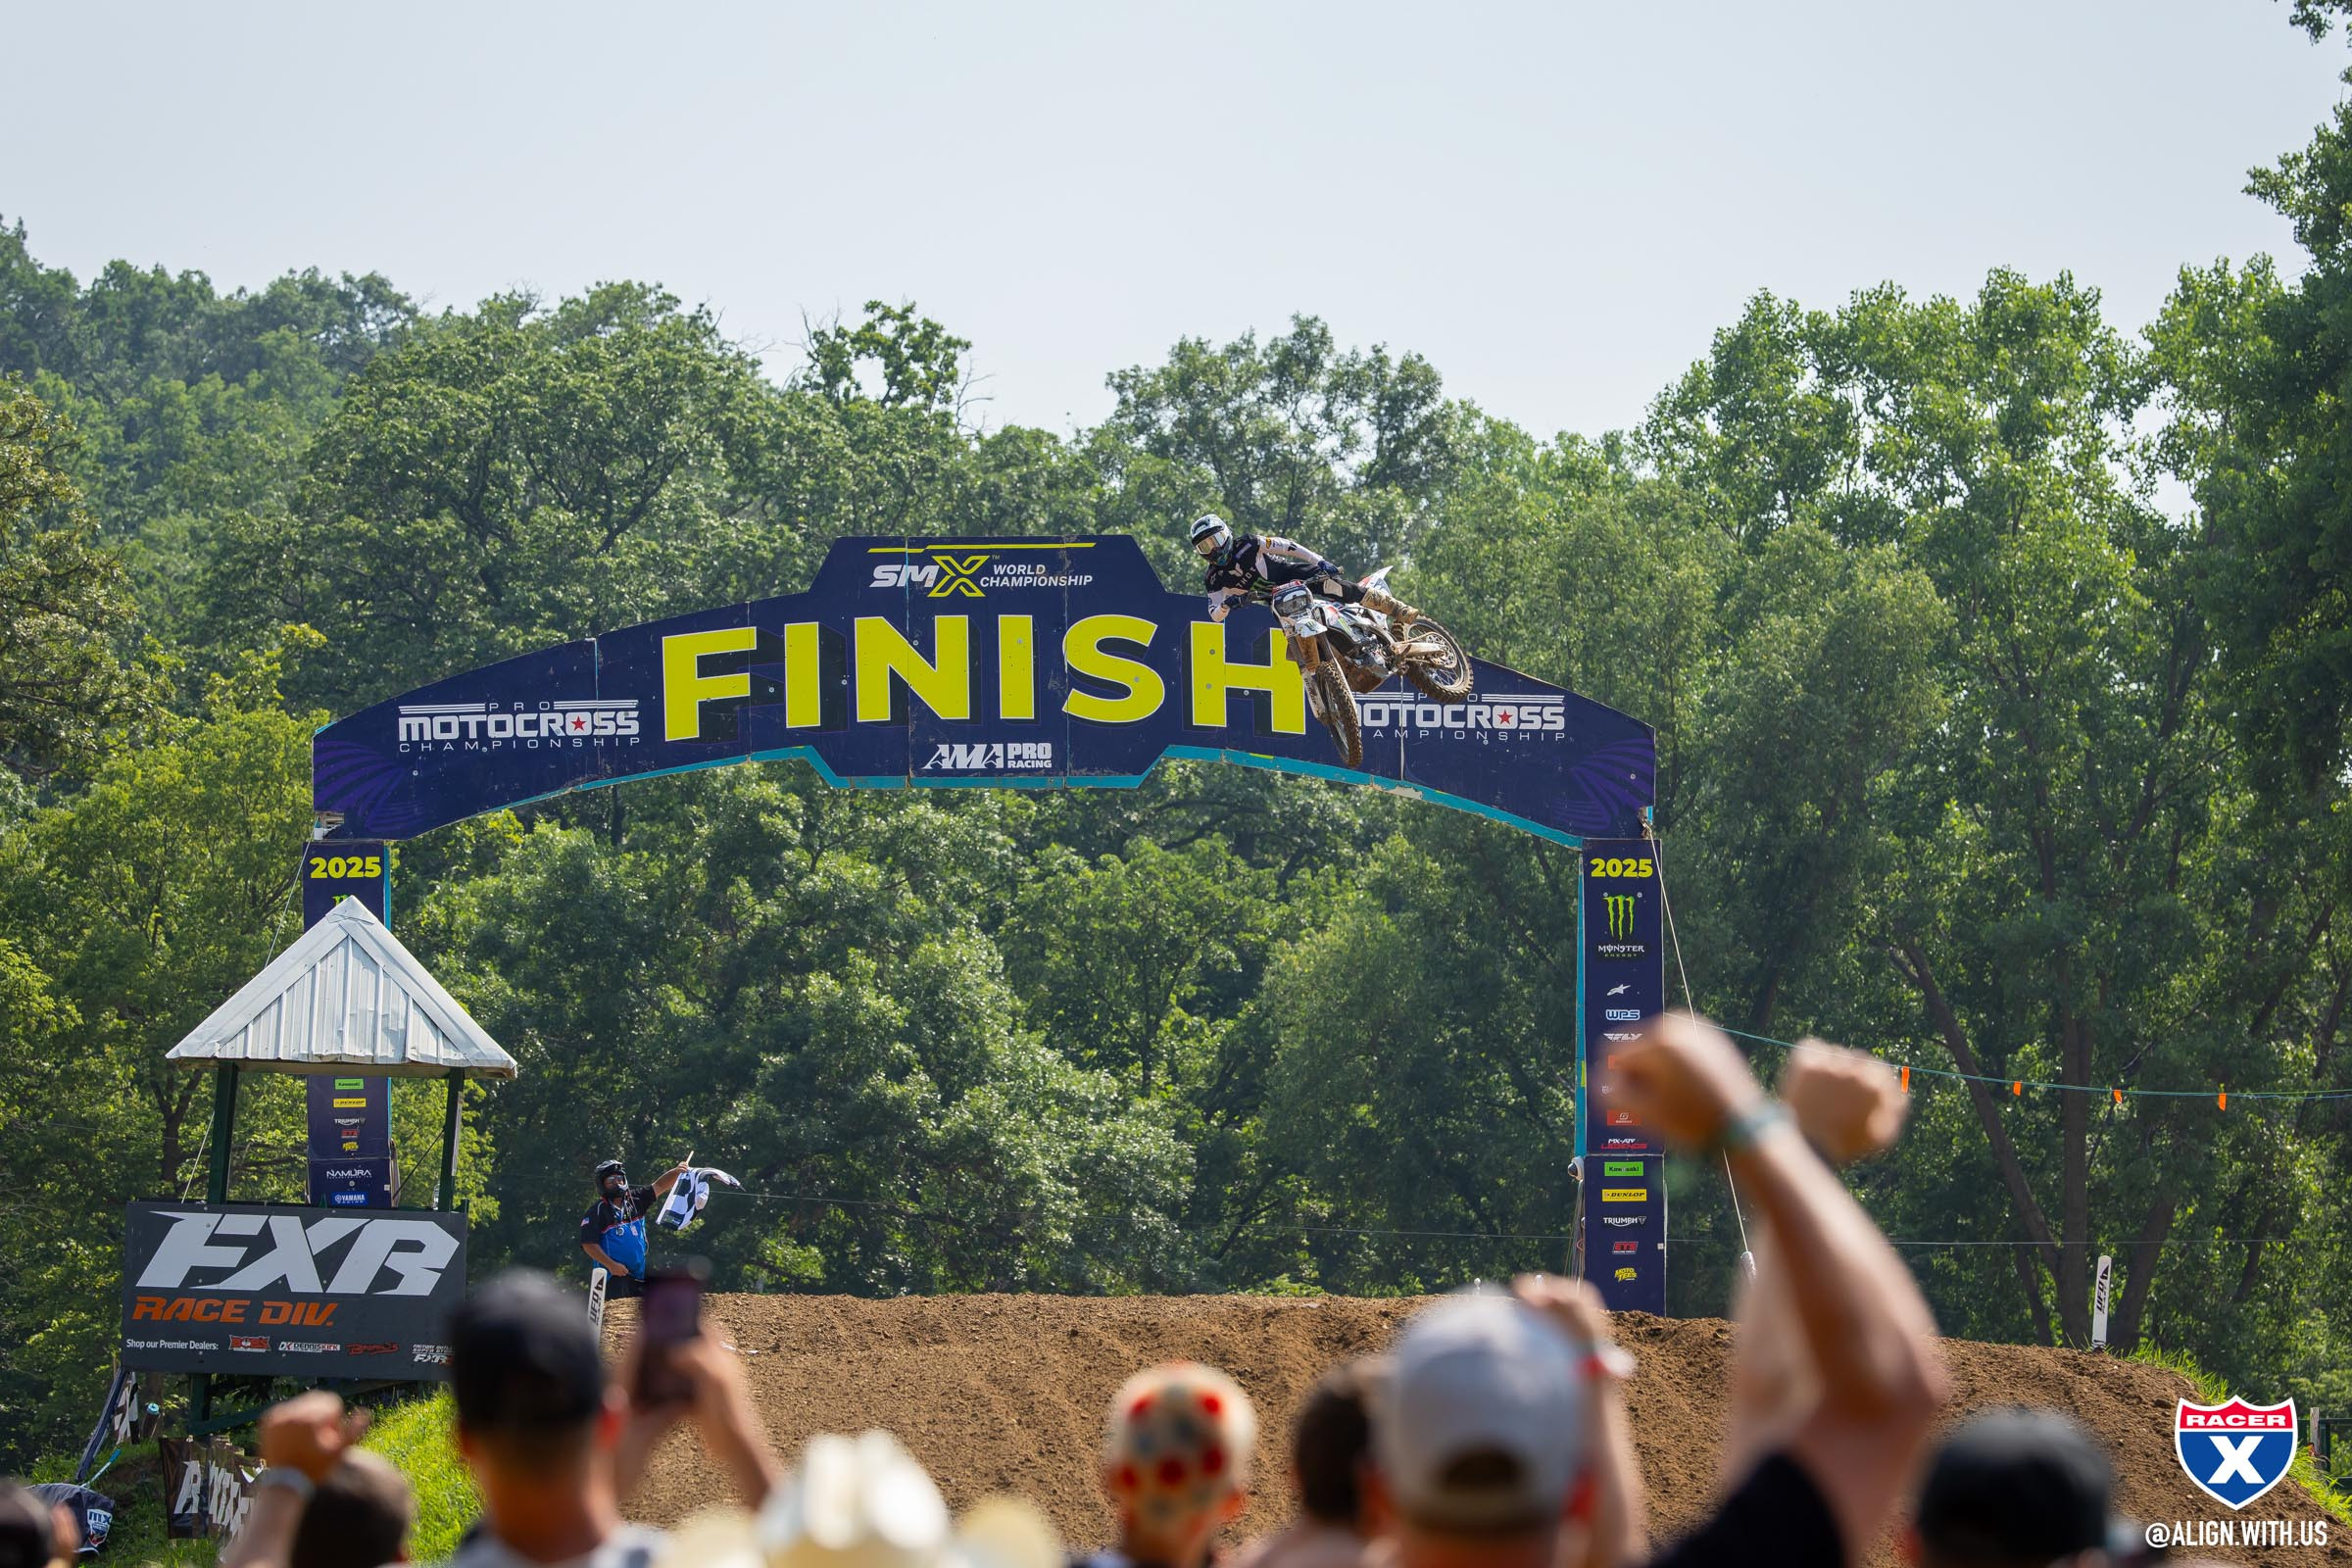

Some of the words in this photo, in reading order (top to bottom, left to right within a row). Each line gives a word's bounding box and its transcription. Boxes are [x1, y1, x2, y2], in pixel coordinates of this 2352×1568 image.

[993, 564, 1047, 575] WORLD
[869, 555, 990, 598] SMX
[980, 575, 1093, 587] CHAMPIONSHIP
[662, 613, 1306, 741] FINISH
[1418, 693, 1478, 703] PO
[489, 702, 550, 711] PRO
[399, 711, 640, 742] MOTOCROSS
[1359, 729, 1565, 741] AMPIONSHIP
[400, 738, 640, 753] CHAMPIONSHIP
[922, 744, 1004, 769] AMA
[1007, 743, 1052, 760] PRO
[309, 857, 382, 878] 2025
[1590, 858, 1653, 878] 2025
[1598, 944, 1644, 954] MONSTER
[1606, 1009, 1640, 1020] WPS
[326, 1168, 371, 1178] NAMURA
[1603, 1217, 1638, 1226] TRIUMPH
[135, 1211, 461, 1296] FXR
[132, 1296, 251, 1322] RACE
[259, 1300, 338, 1327] DIV.
[126, 1339, 145, 1349] Shop
[159, 1340, 188, 1349] Premier
[189, 1341, 219, 1350] Dealers:
